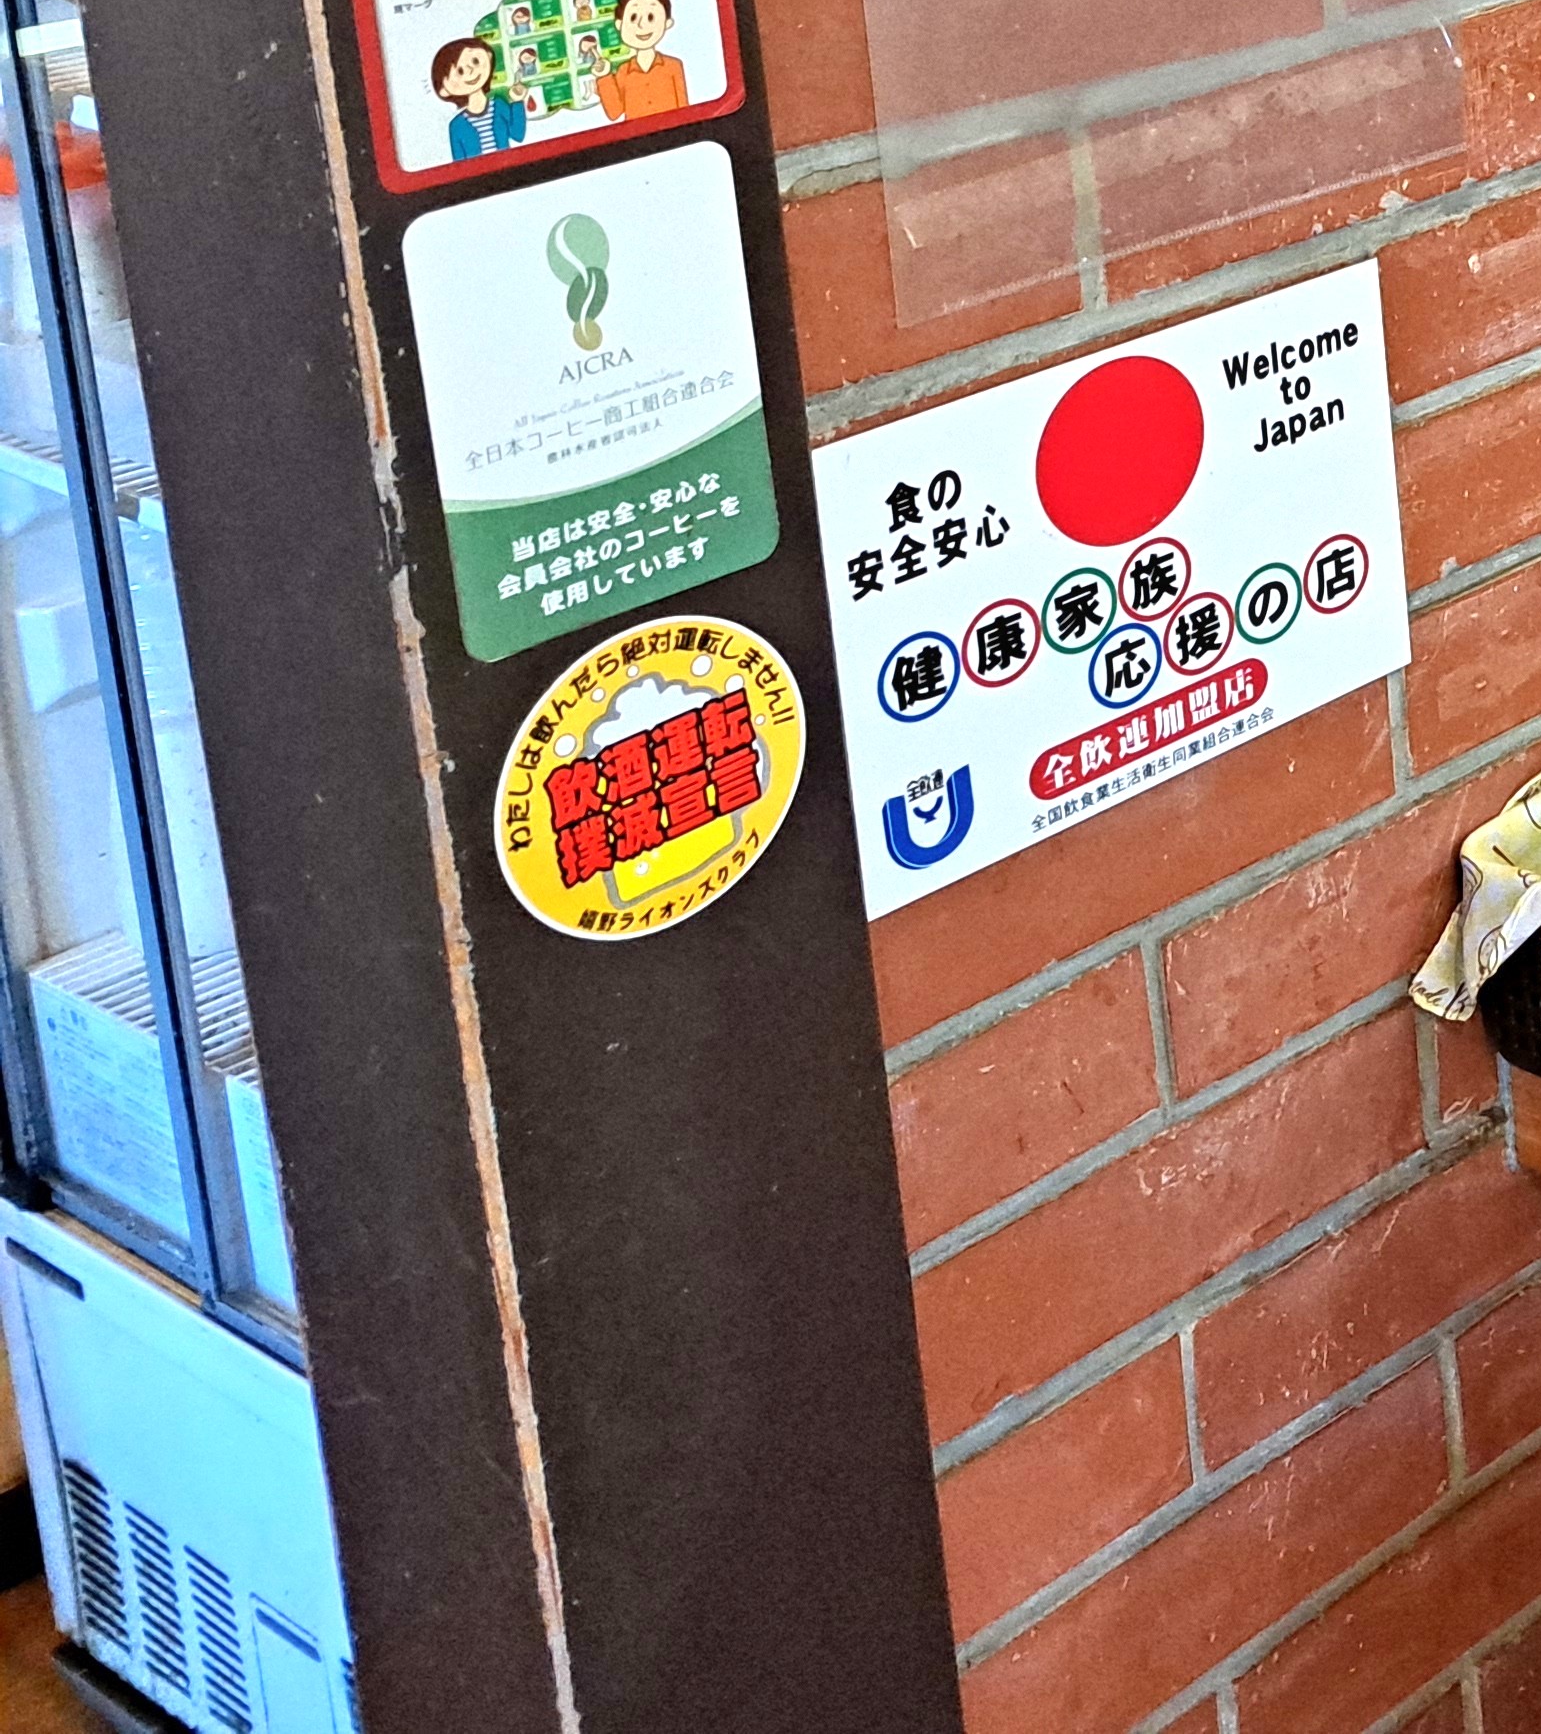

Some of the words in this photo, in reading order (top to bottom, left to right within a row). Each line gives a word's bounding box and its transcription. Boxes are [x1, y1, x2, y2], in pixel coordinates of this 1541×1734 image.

[557, 347, 635, 384] AJCRA
[1221, 321, 1360, 390] Welcome
[1279, 372, 1312, 406] to
[465, 369, 735, 472] 全日本コーヒー商工組合連合会
[1252, 398, 1346, 452] Japan
[497, 496, 742, 600] 会員会社のコーヒーを
[511, 472, 721, 564] 当店は安全・安心な
[885, 469, 962, 534] 食の
[539, 537, 709, 617] 使用しています
[846, 504, 1011, 602] 安全安心
[890, 552, 1180, 712] 健康家族
[1100, 544, 1358, 699] 応援の店
[545, 688, 757, 830] 飲酒運転
[1031, 706, 1275, 833] 全国飲食業生活衛生同業組合連合会
[1042, 666, 1257, 794] 全飲連加盟店
[555, 747, 762, 890] 撲滅宣言
